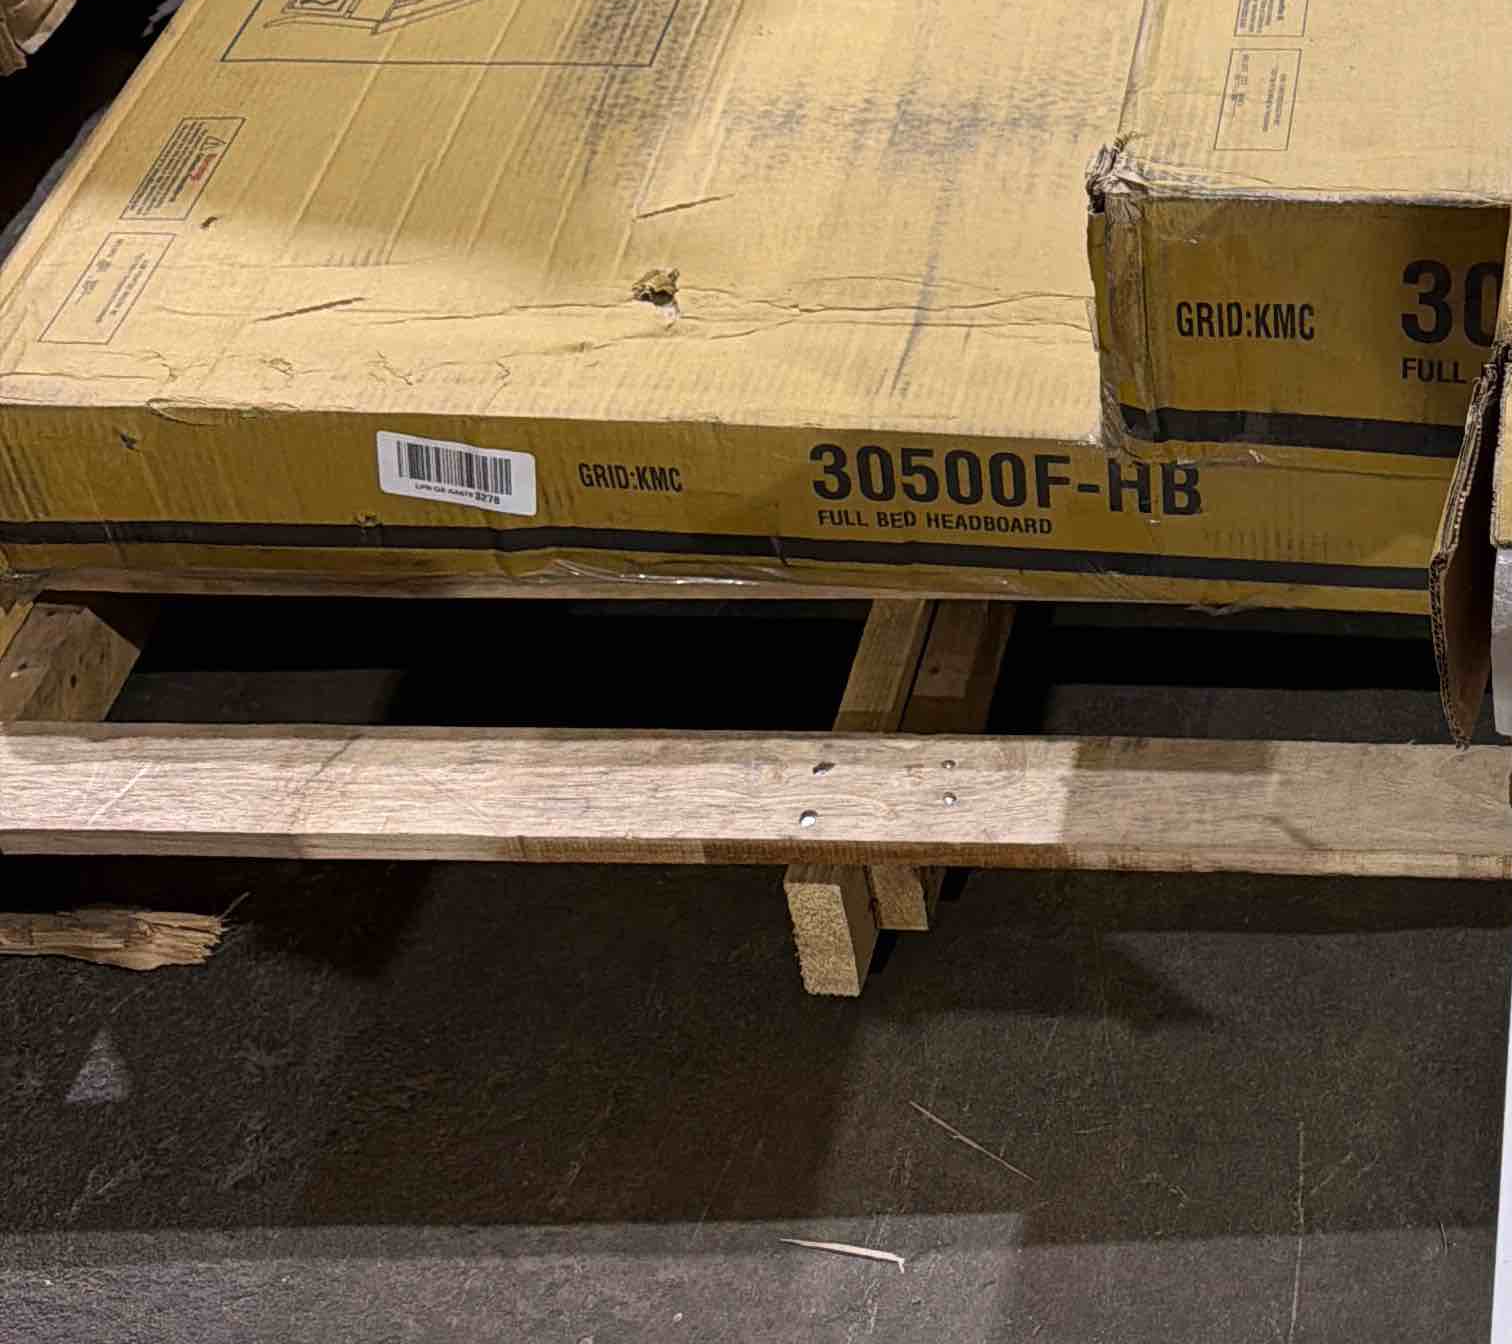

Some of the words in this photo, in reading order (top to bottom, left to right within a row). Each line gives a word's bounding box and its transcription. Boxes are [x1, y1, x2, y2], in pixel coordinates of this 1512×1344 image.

[1176, 301, 1316, 341] GRID:KMC
[1402, 357, 1467, 385] FULL
[577, 461, 683, 493] GRID:KMC
[808, 442, 1202, 516] 30500F-HB
[816, 508, 868, 528] FULL
[876, 510, 917, 530] BED
[926, 512, 1054, 536] HEADBOARD
